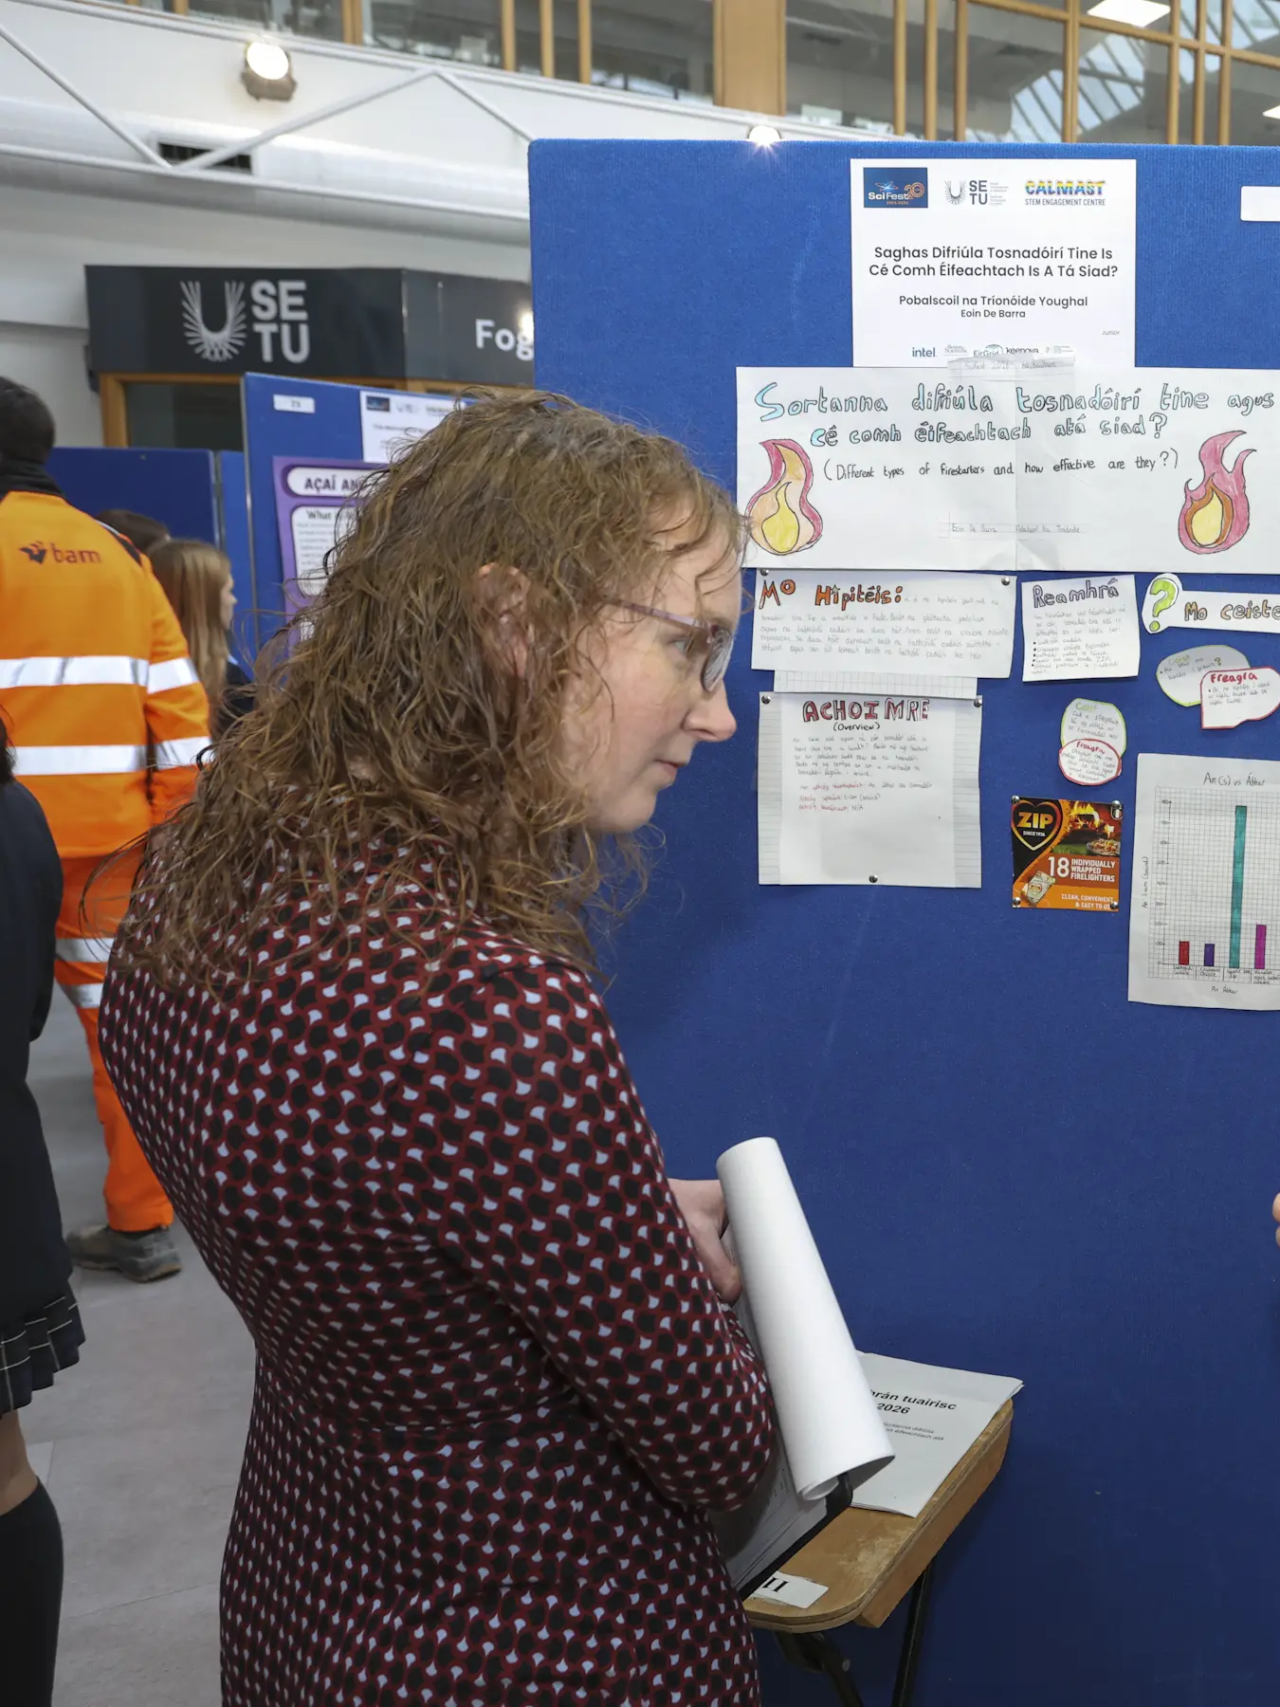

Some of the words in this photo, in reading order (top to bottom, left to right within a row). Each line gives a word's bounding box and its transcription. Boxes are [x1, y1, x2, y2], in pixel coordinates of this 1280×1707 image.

[969, 180, 987, 192] SE
[1025, 180, 1106, 195] CALMAST
[868, 191, 908, 200] SciFest
[969, 193, 987, 205] TU
[874, 246, 928, 262] Saghas
[932, 246, 983, 258] Difriúla
[987, 246, 1063, 259] Tosnadóirí
[1067, 246, 1098, 259] Tine
[1101, 248, 1113, 259] Is
[869, 263, 889, 276] Cé
[892, 264, 936, 276] Comh
[940, 262, 1024, 276] Éifeachtach
[1029, 265, 1040, 276] Is
[1044, 265, 1054, 277] A
[1057, 264, 1075, 277] Tá
[1079, 264, 1118, 277] Siad?
[250, 280, 309, 321] SE
[899, 295, 959, 305] Pobalscoil
[962, 297, 978, 305] na
[980, 295, 1036, 306] Tríonóide
[1039, 296, 1088, 309] Youghal
[960, 309, 981, 317] Eoin
[983, 309, 997, 317] De
[999, 309, 1026, 318] Barra
[254, 323, 311, 364] TU
[912, 347, 936, 357] intel
[754, 382, 888, 422] Sortanna
[1016, 384, 1142, 413] tosnadóirí
[1159, 383, 1209, 411] tine
[1226, 391, 1275, 416] agus
[810, 425, 838, 447] cé
[849, 424, 902, 444] comh
[914, 418, 1031, 444] éifeachtach
[1053, 414, 1086, 437] atá
[883, 466, 904, 479] types
[919, 463, 930, 475] of
[993, 463, 1015, 475] and
[1024, 461, 1044, 474] how
[1053, 457, 1096, 472] effective
[1108, 459, 1126, 470] are
[759, 579, 796, 610] Mo
[815, 584, 903, 611] Hipitéis:
[1032, 577, 1119, 608] Reamhrá
[1184, 601, 1208, 621] Mo
[1210, 672, 1257, 684] Freagra
[833, 722, 881, 731] (Overview)
[1017, 811, 1053, 829] ZIP
[1048, 856, 1070, 877] 18
[1071, 858, 1116, 868] INDIVIDUALLY
[1071, 866, 1101, 874] WRAPPED
[1070, 873, 1115, 882] FIRELIGHTERS
[1061, 893, 1079, 901] CLEAN,
[877, 1402, 911, 1414] 2026
[902, 1396, 957, 1410] tuairisc
